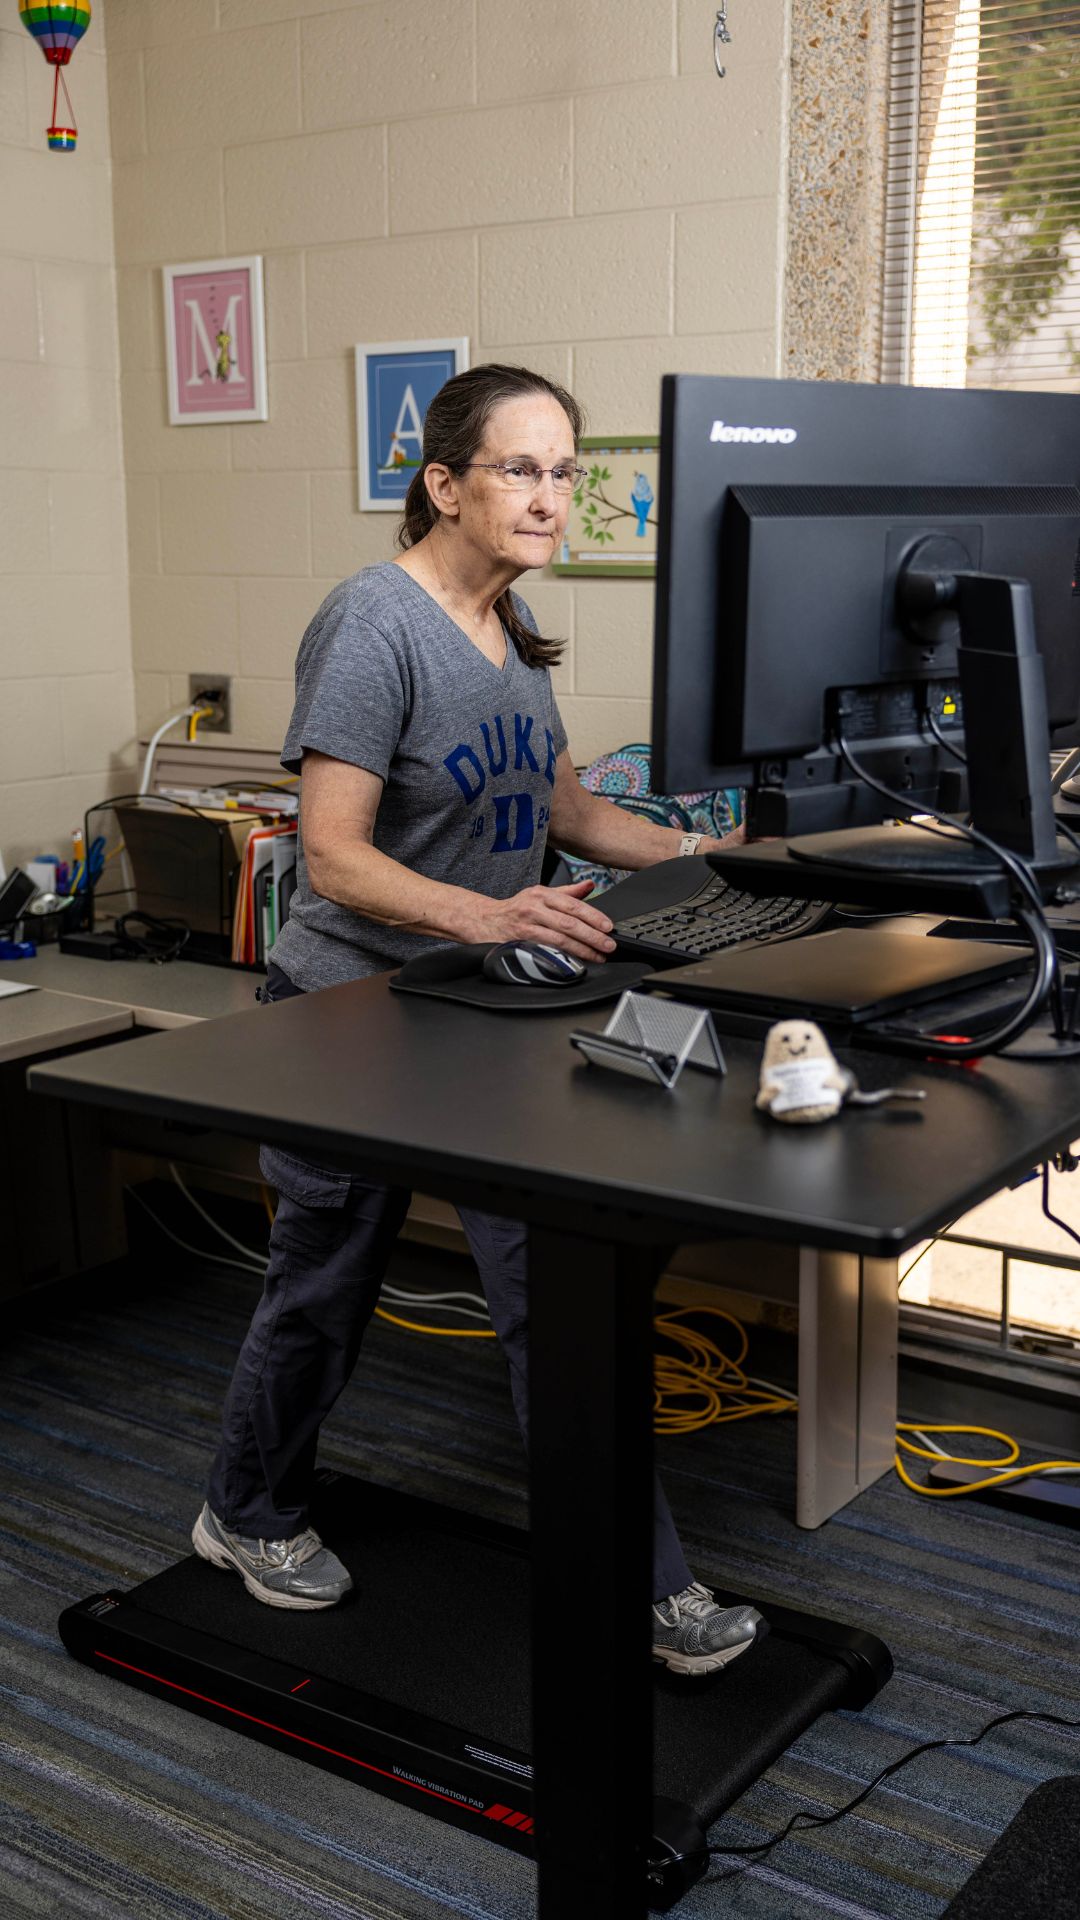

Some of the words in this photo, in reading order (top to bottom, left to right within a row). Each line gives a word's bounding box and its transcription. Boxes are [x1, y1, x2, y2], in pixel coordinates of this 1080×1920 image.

[184, 295, 246, 387] M
[377, 383, 424, 474] A
[709, 420, 797, 444] lenovo
[470, 815, 485, 839] 19
[490, 792, 534, 853] D
[392, 1765, 427, 1786] WALKING
[427, 1780, 467, 1803] VIBRATION
[468, 1797, 485, 1809] PAD
